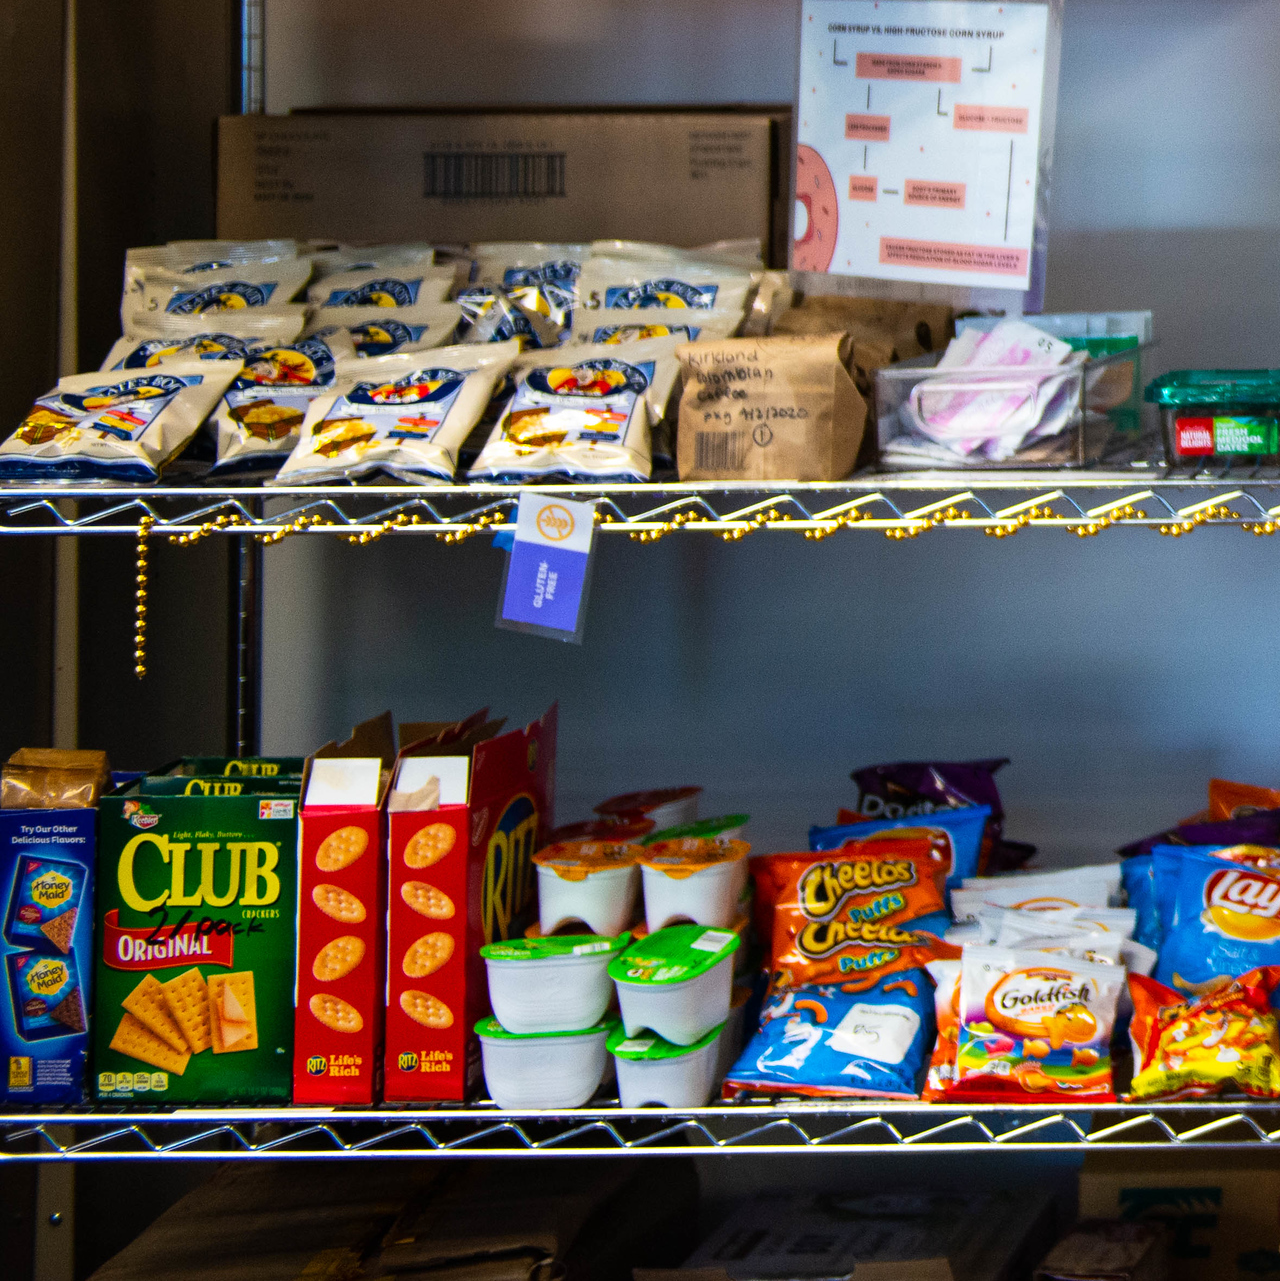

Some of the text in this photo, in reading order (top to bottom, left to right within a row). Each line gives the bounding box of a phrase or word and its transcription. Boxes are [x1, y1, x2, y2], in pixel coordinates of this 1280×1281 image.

[828, 23, 1005, 40] CORN SYRUP CORN SYRUP
[688, 350, 758, 368] Kirkland
[1180, 431, 1211, 440] NATURAL
[1216, 428, 1248, 436] FRESH
[1180, 439, 1212, 448] DELIGHTS
[1216, 435, 1264, 444] MEDJOOL
[1216, 444, 1249, 452] DATES
[532, 559, 550, 609] GLUTEN
[545, 570, 559, 601] FREE
[131, 814, 159, 826] Keebler
[21, 824, 78, 835] Try Our Other
[12, 835, 87, 845] Delicious Flavors:
[117, 833, 282, 913] CLUB
[33, 879, 74, 893] Honey
[800, 860, 915, 918] Cheetos
[40, 888, 67, 901] Maid
[242, 909, 280, 919] CRACKERS
[849, 893, 905, 923] Puffs
[118, 934, 213, 962] ORIGINAL
[838, 948, 900, 974] Puffs
[30, 964, 67, 985] Honey
[37, 974, 64, 988] Maid
[1000, 983, 1091, 1010] Goldfish
[308, 1054, 362, 1075] RITZ Life's
[398, 1050, 453, 1070] RITZ Life's
[421, 1061, 451, 1073] Rich
[102, 1074, 113, 1083] 70
[329, 1065, 360, 1078] Rich
